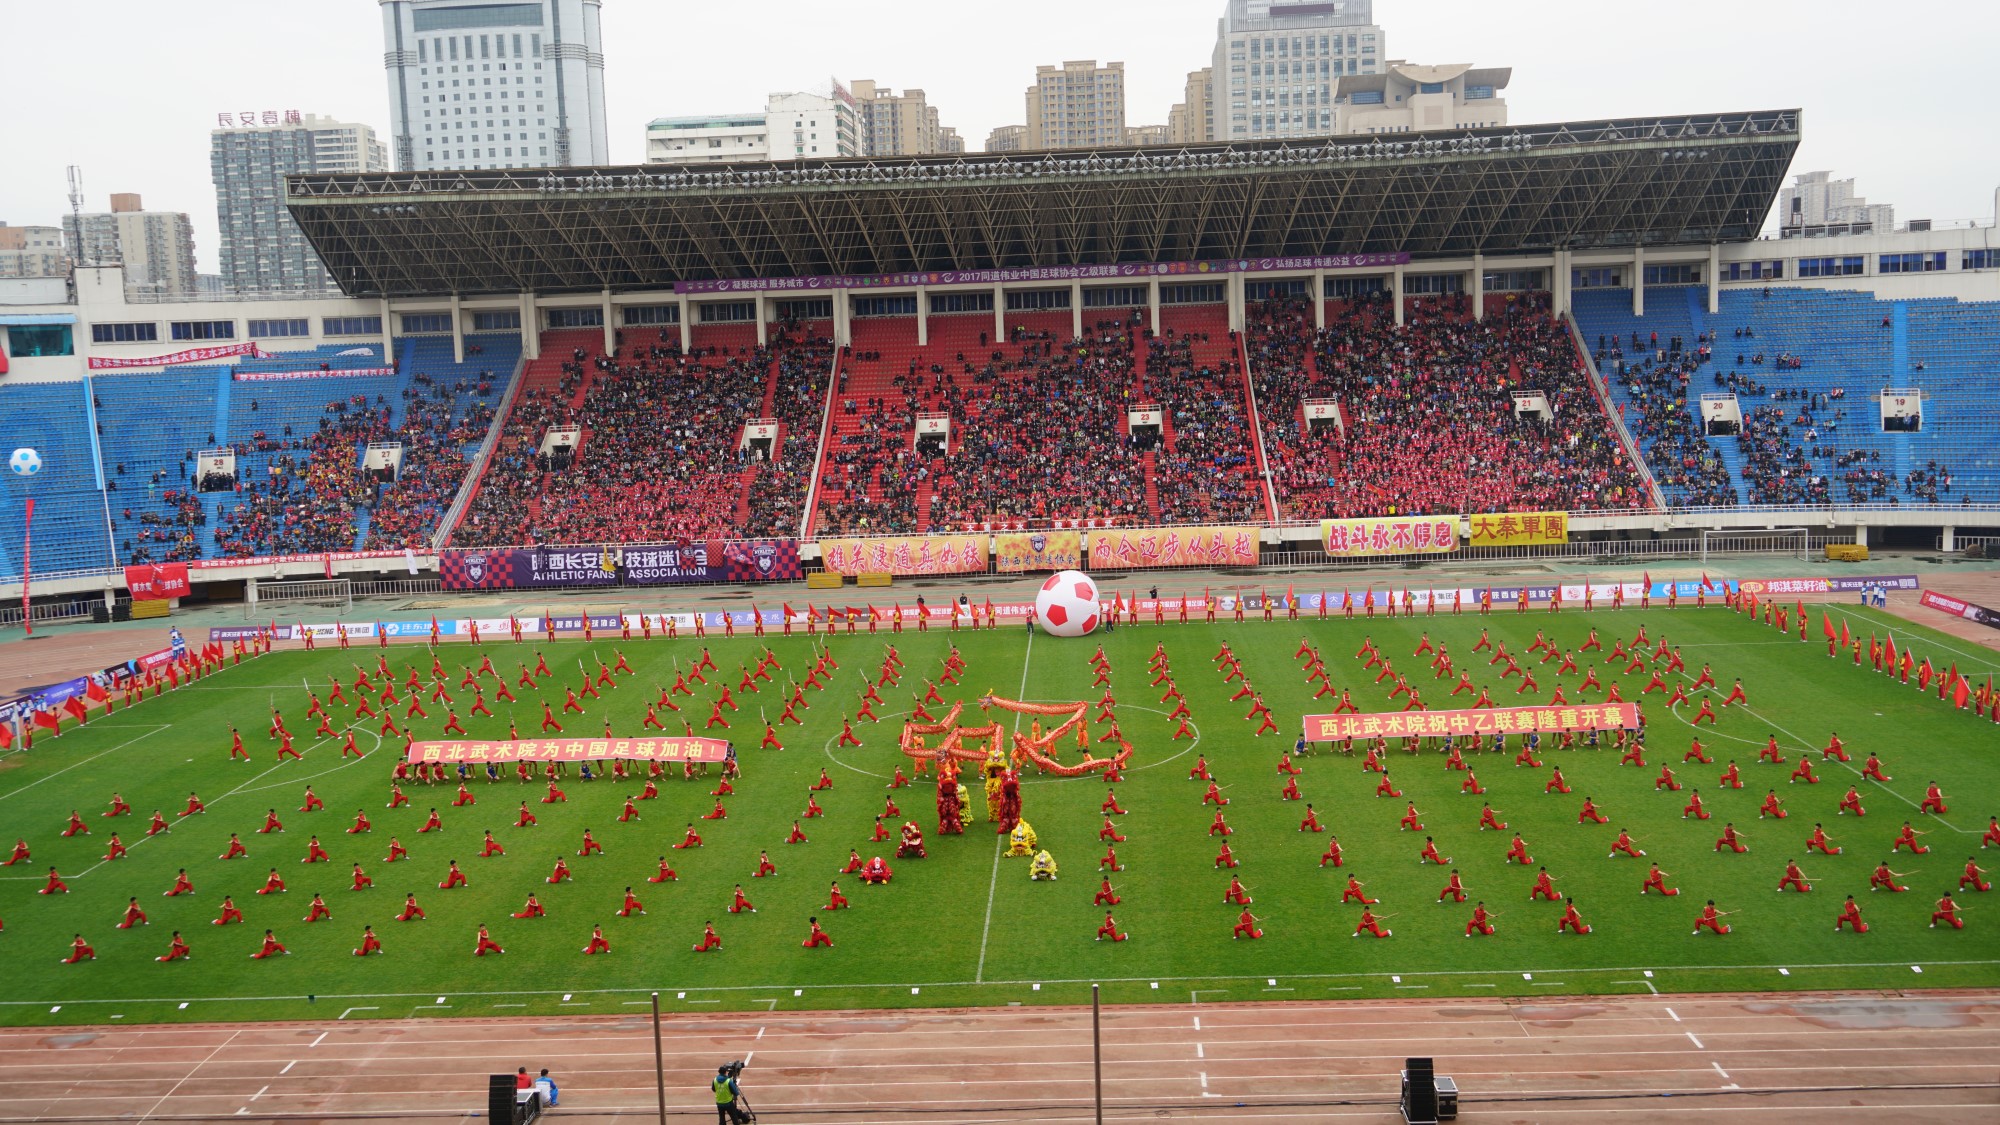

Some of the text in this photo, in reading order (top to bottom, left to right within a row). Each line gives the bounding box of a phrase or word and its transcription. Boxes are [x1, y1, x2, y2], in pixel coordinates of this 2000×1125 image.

[1276, 257, 1312, 269] 弘扬足球
[959, 266, 1119, 282] 2017同道伟业中国足球协会乙级联赛
[732, 278, 804, 290] 凝聚球迷 服务城市
[1522, 399, 1531, 407] 21
[1713, 402, 1724, 410] 20
[1895, 398, 1905, 406] 19
[1140, 413, 1150, 421] 23
[1473, 515, 1563, 540] 大秦軍團
[1329, 521, 1453, 551] 战斗永不停息
[1094, 531, 1254, 564] 而今迈步从头越
[827, 539, 982, 571] 雄关漫道真如铁
[1001, 553, 1077, 567] 陕西省球迷协会
[533, 566, 706, 581] ATHLETIC FANS ASSOCIATION
[1768, 580, 1828, 593] 邦淇菜籽油
[1319, 706, 1624, 737] 西北武术院祝中乙联赛隆重开幕
